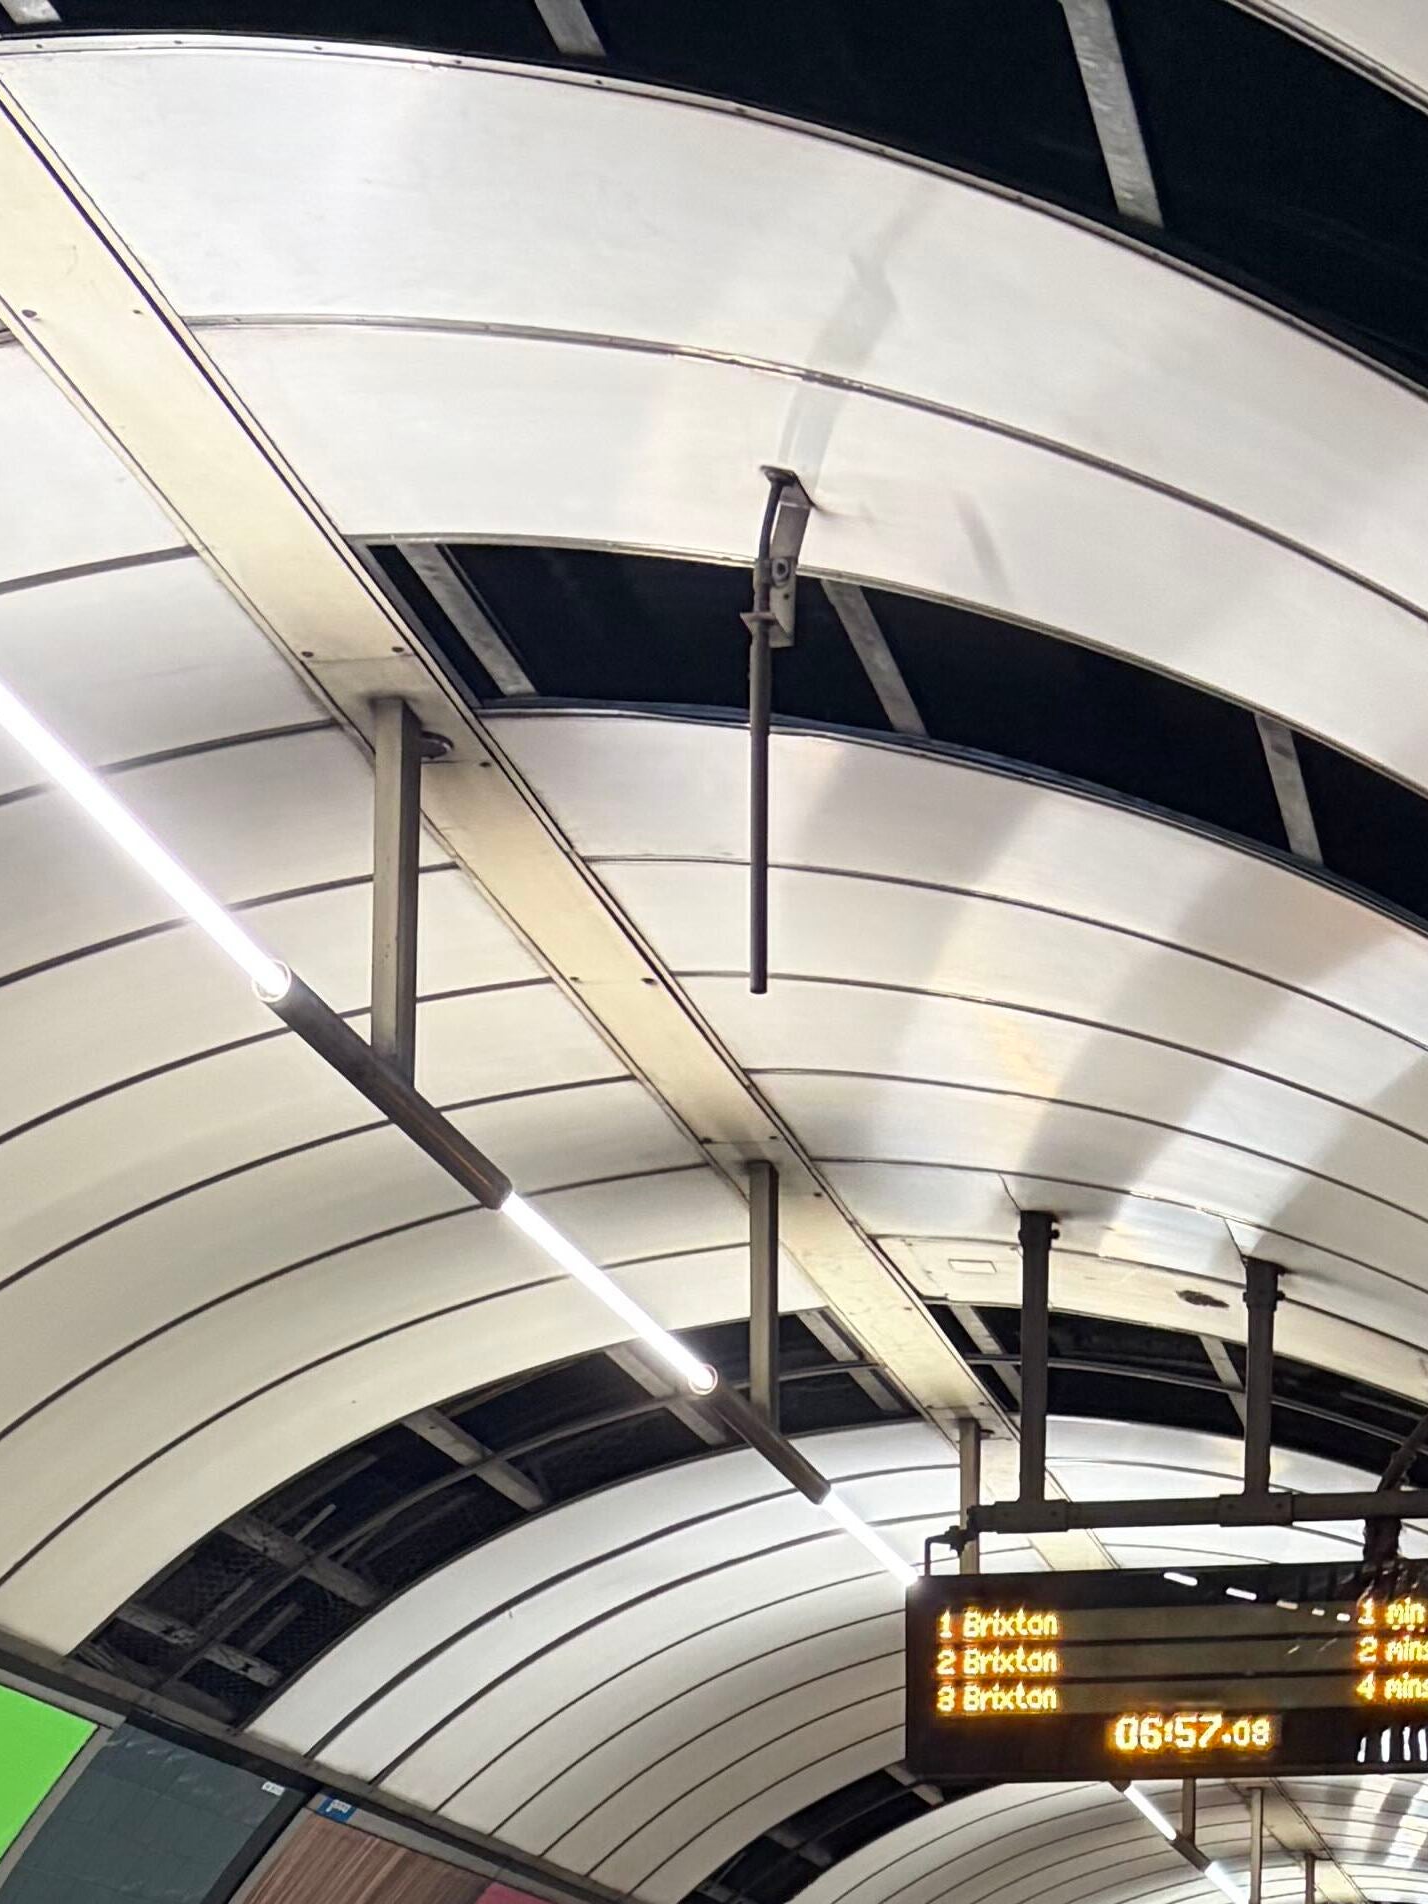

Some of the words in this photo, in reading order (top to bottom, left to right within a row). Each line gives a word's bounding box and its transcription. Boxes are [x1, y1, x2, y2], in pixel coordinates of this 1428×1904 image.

[938, 1606, 953, 1639] 1
[962, 1606, 1059, 1639] Brixton
[1357, 1598, 1376, 1626] 1
[1385, 1597, 1427, 1626] min
[936, 1648, 956, 1676] 2
[962, 1646, 1058, 1675] Brixton
[1357, 1636, 1378, 1664] 2
[936, 1684, 956, 1713] 3
[962, 1682, 1058, 1712] Brixton
[1356, 1672, 1376, 1701] 4
